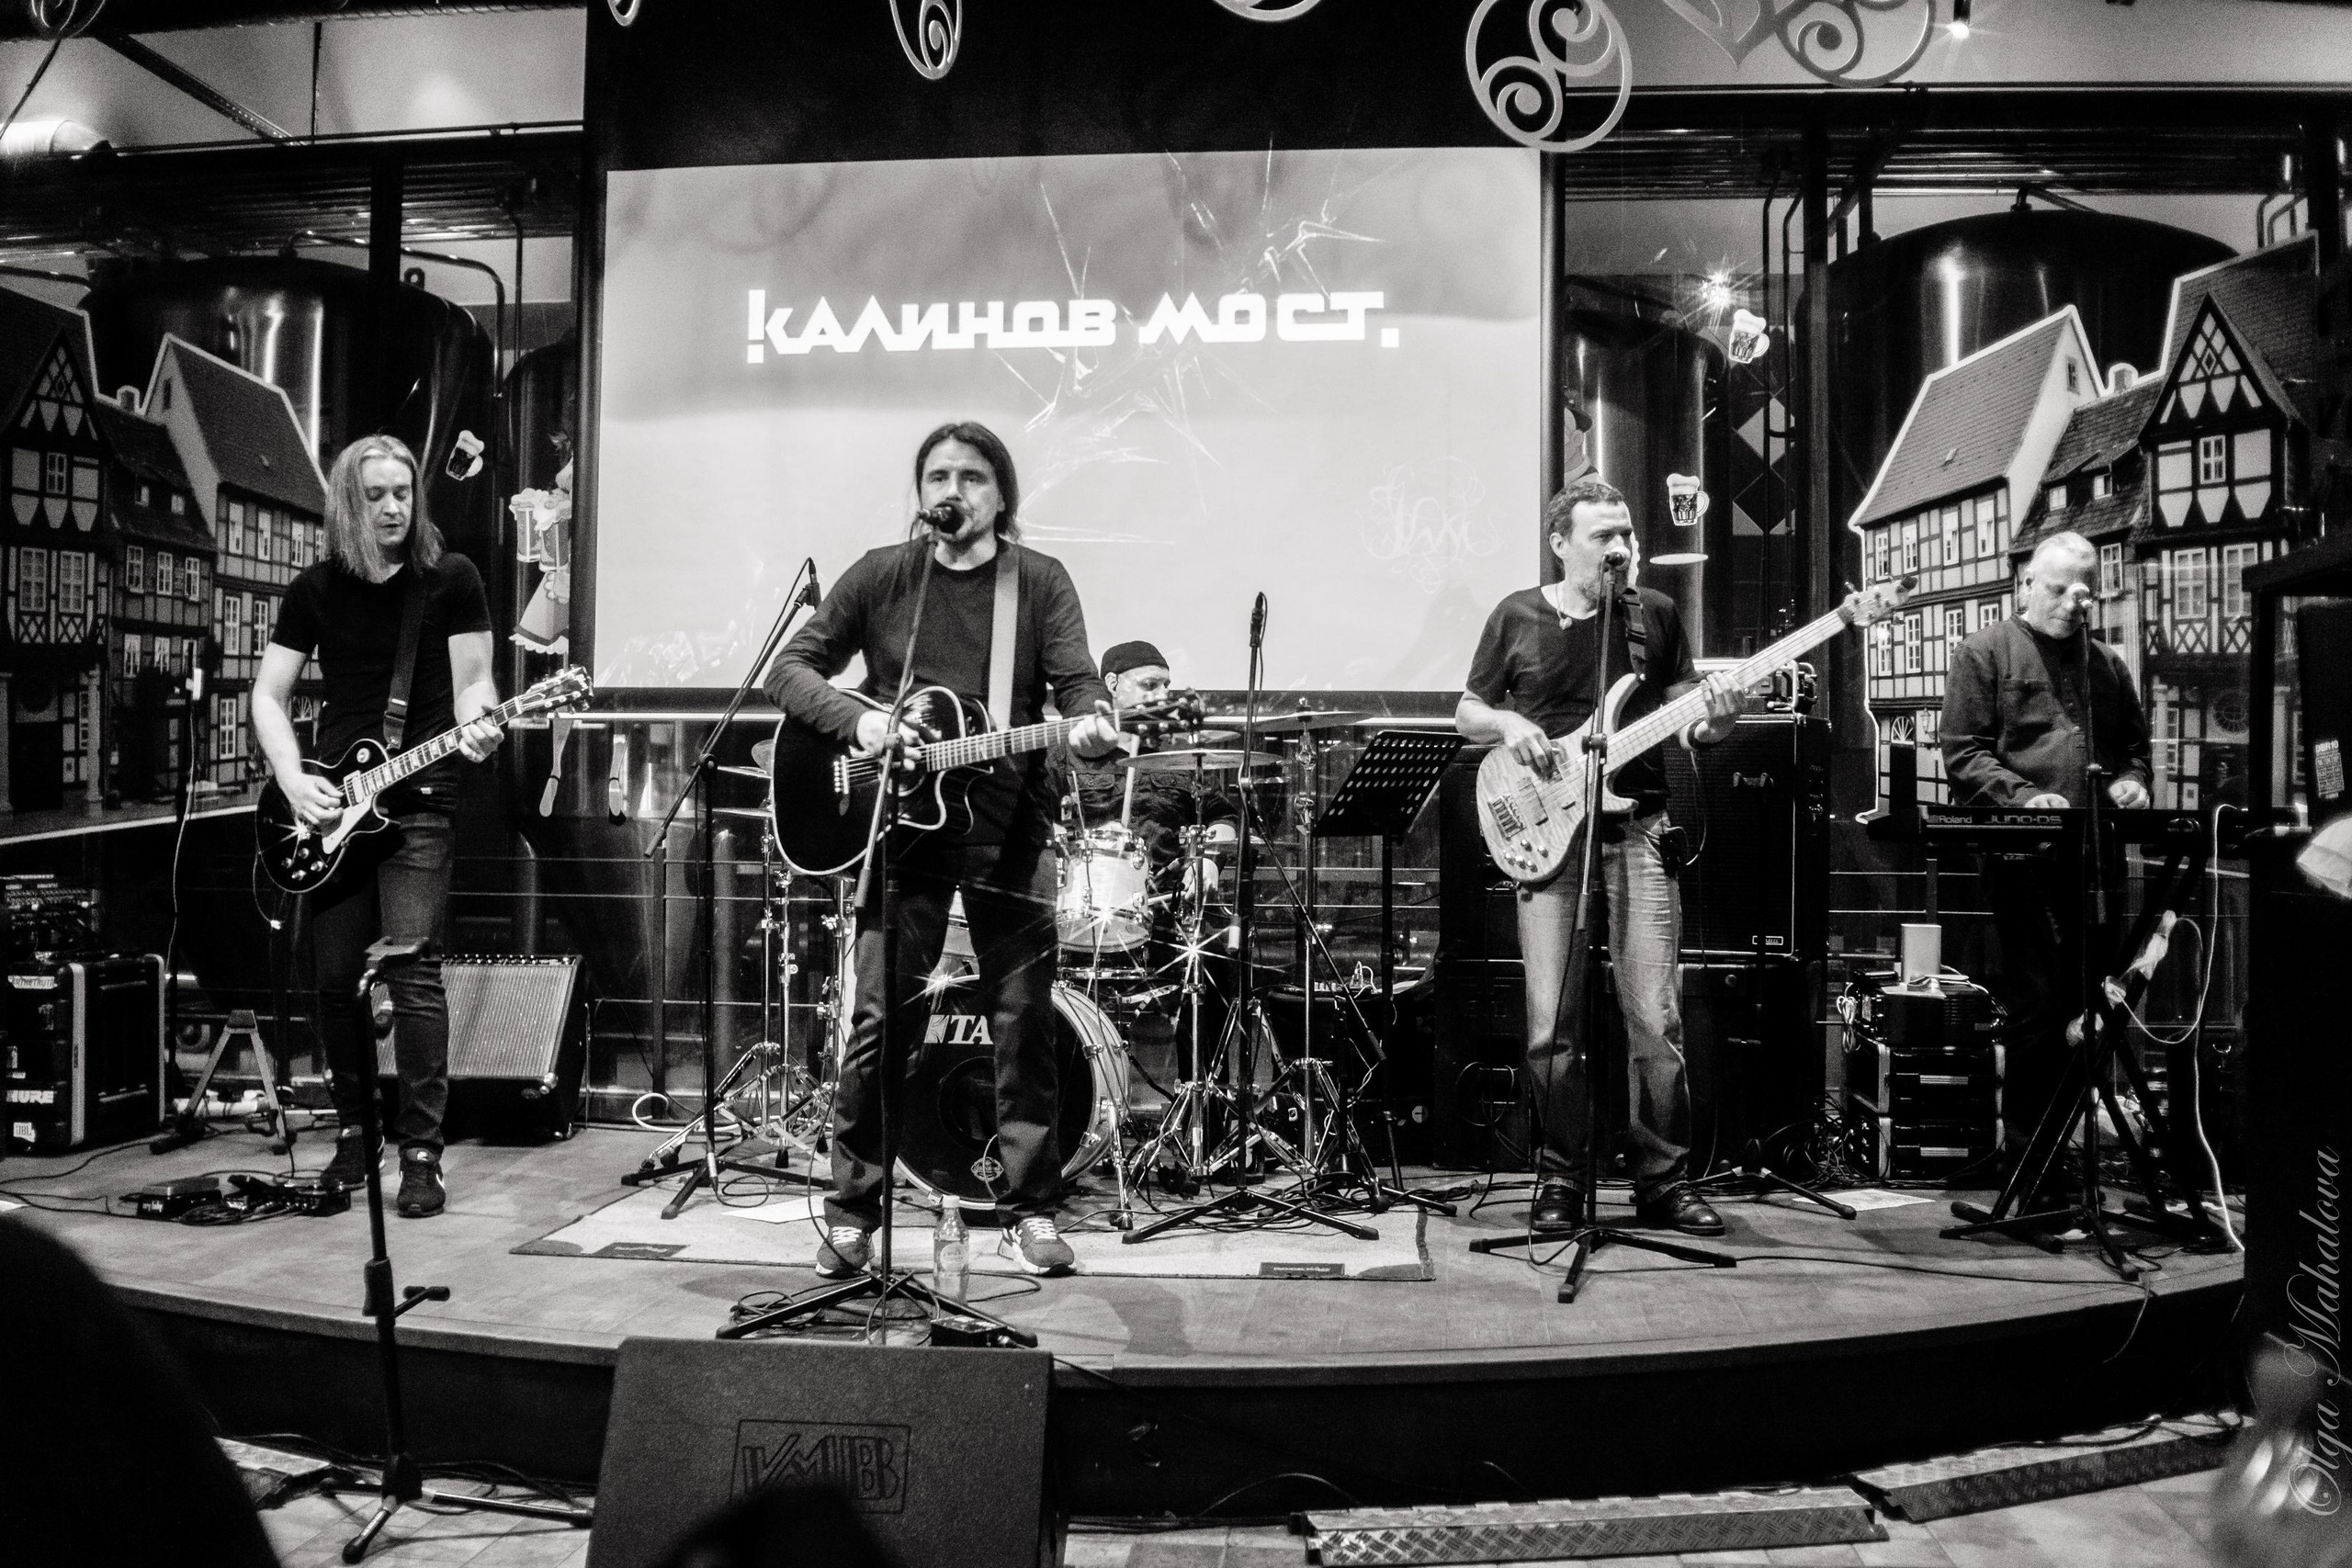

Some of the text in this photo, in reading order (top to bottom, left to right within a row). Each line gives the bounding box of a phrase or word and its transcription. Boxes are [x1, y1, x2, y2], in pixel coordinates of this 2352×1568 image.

[2315, 739, 2339, 753] DBR10
[1938, 815, 1973, 824] Roland
[947, 1014, 994, 1045] TA
[6, 1089, 54, 1104] HURE
